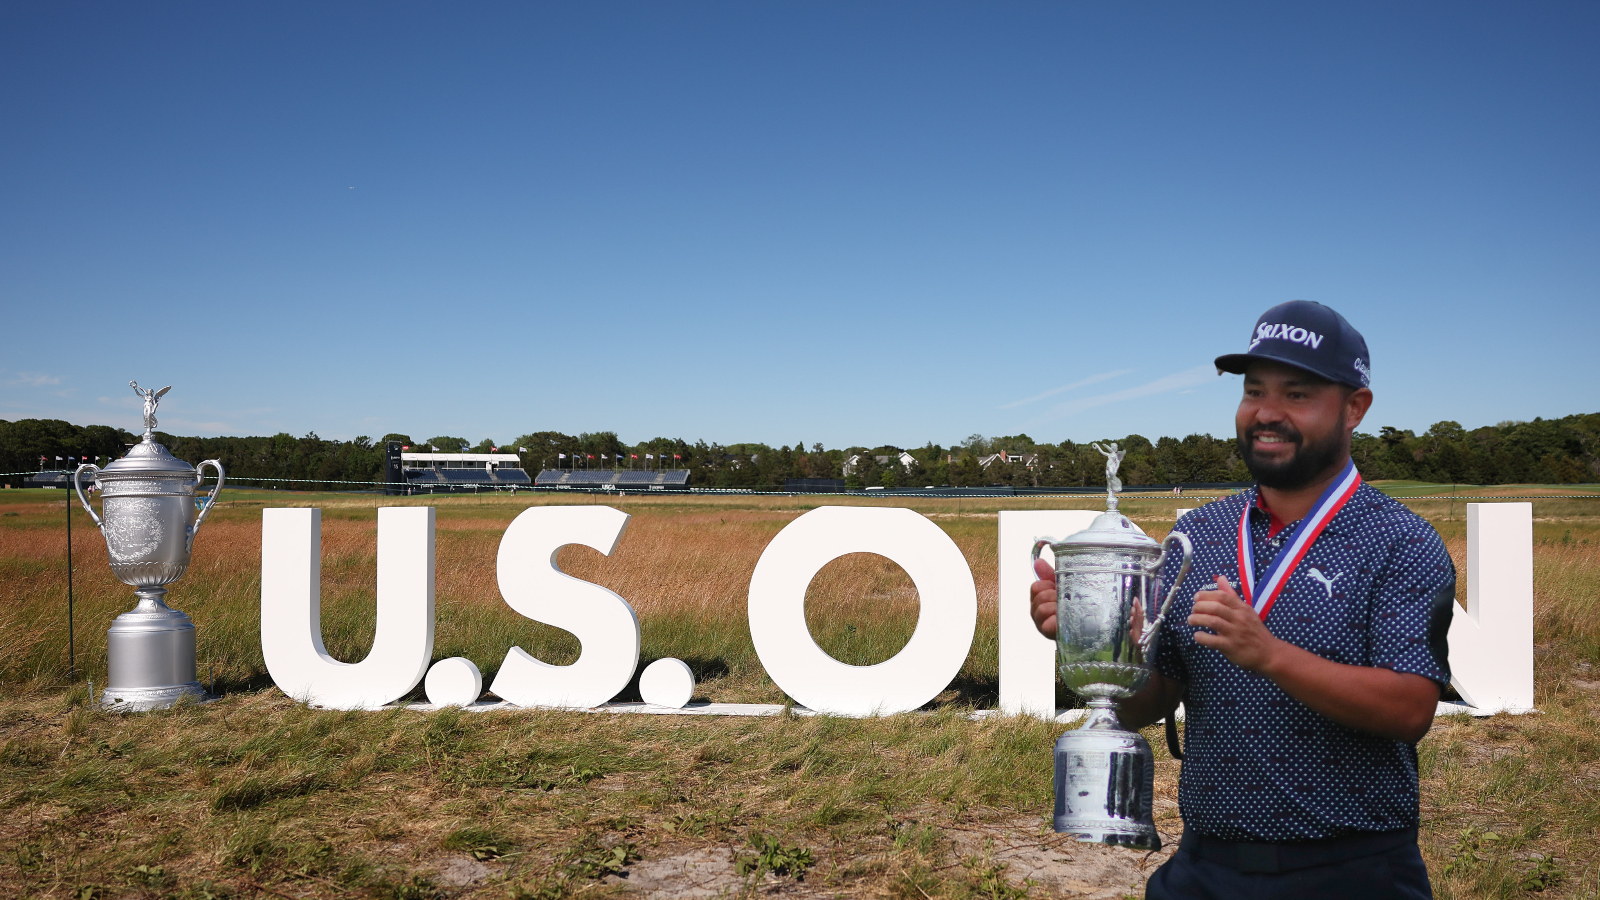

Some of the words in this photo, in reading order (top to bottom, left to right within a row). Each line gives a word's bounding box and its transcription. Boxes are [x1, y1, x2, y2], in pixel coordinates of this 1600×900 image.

[1249, 322, 1323, 351] SRIXON
[260, 505, 696, 712] U.S.
[748, 501, 1534, 721] OPN
